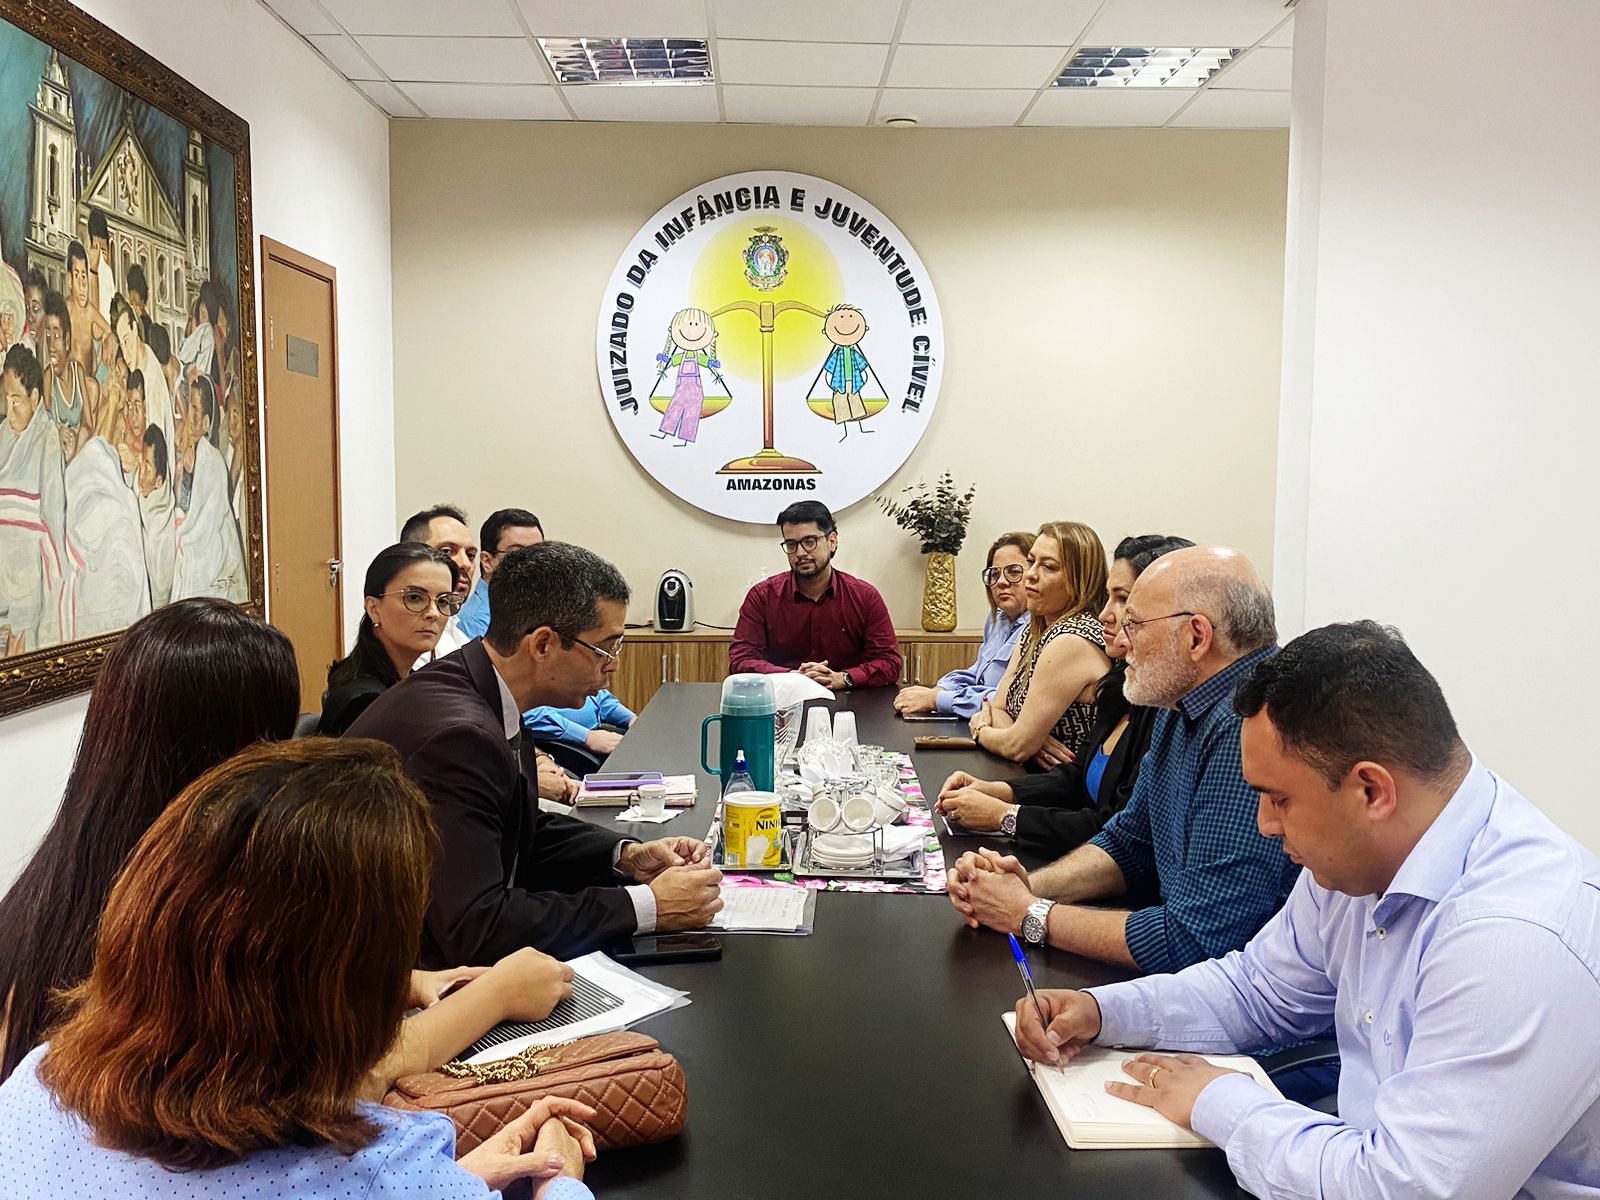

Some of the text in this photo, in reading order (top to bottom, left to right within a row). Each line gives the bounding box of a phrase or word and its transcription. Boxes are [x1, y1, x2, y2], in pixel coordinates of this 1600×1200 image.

[609, 185, 936, 413] JUIZADO DA INFÂNCIA E JUVENTUDE CÍVEL
[726, 478, 816, 491] AMAZONAS
